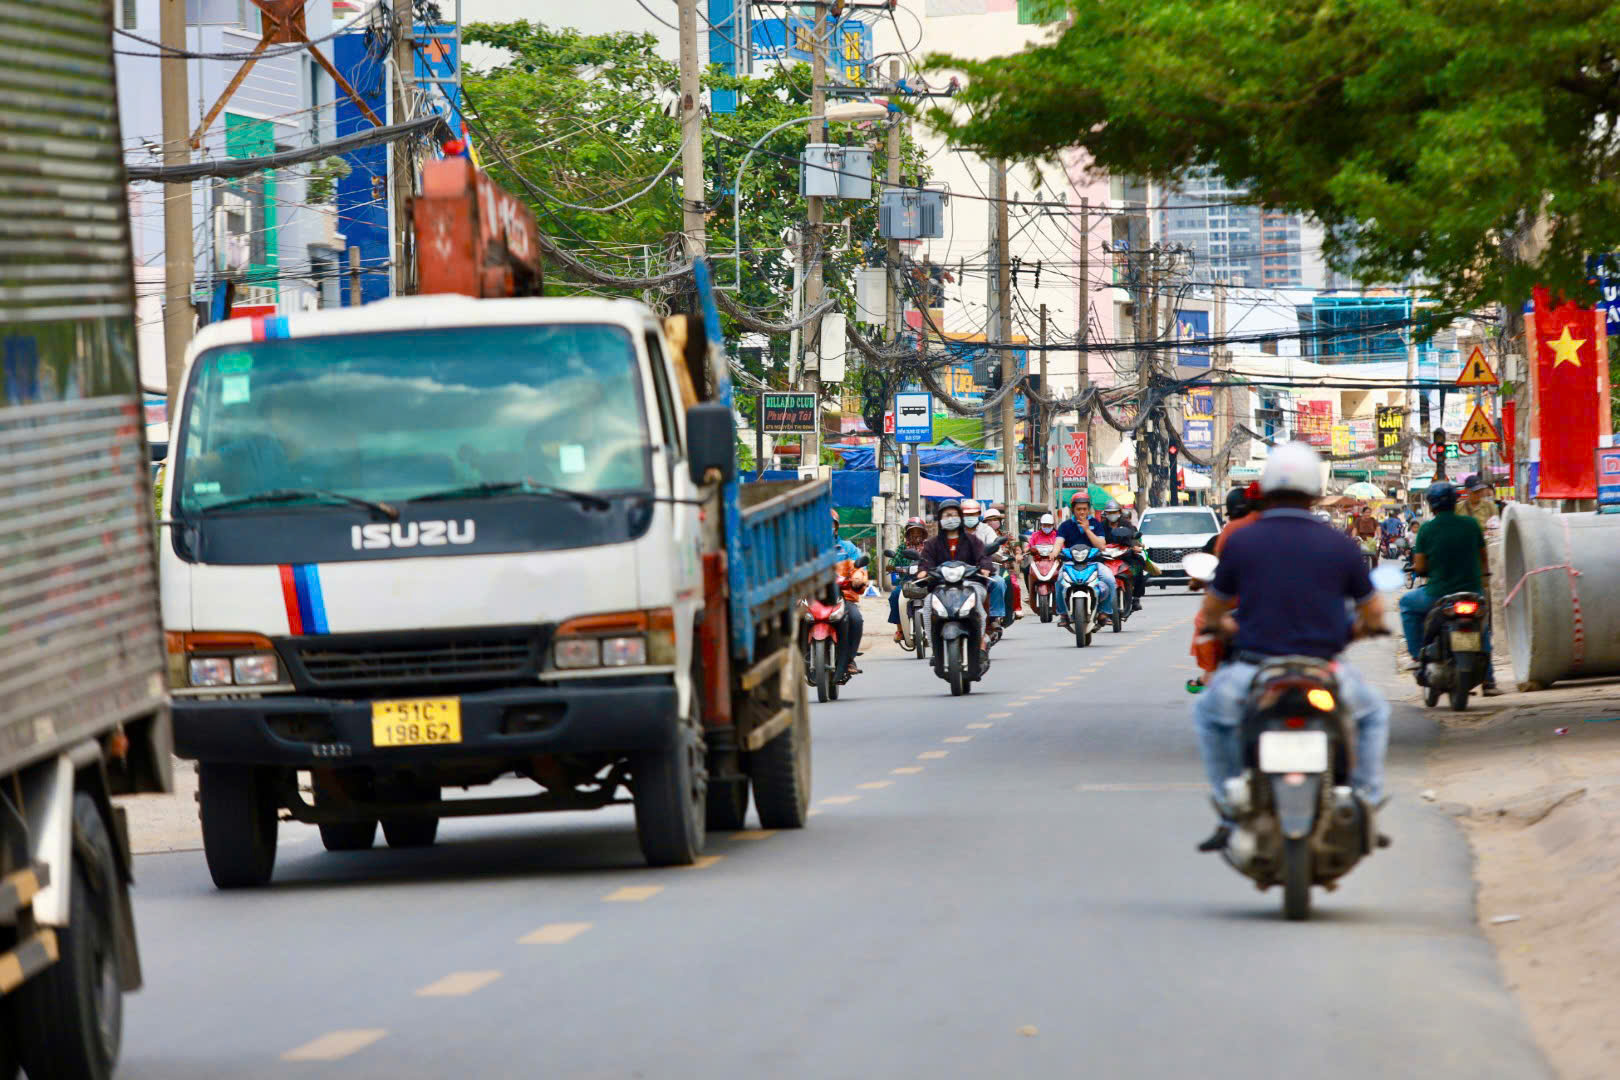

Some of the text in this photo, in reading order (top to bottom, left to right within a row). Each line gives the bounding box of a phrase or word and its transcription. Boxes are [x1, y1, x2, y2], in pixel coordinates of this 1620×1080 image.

[796, 397, 814, 408] CLUB
[351, 519, 476, 550] ISUZU
[397, 702, 434, 721] 51C
